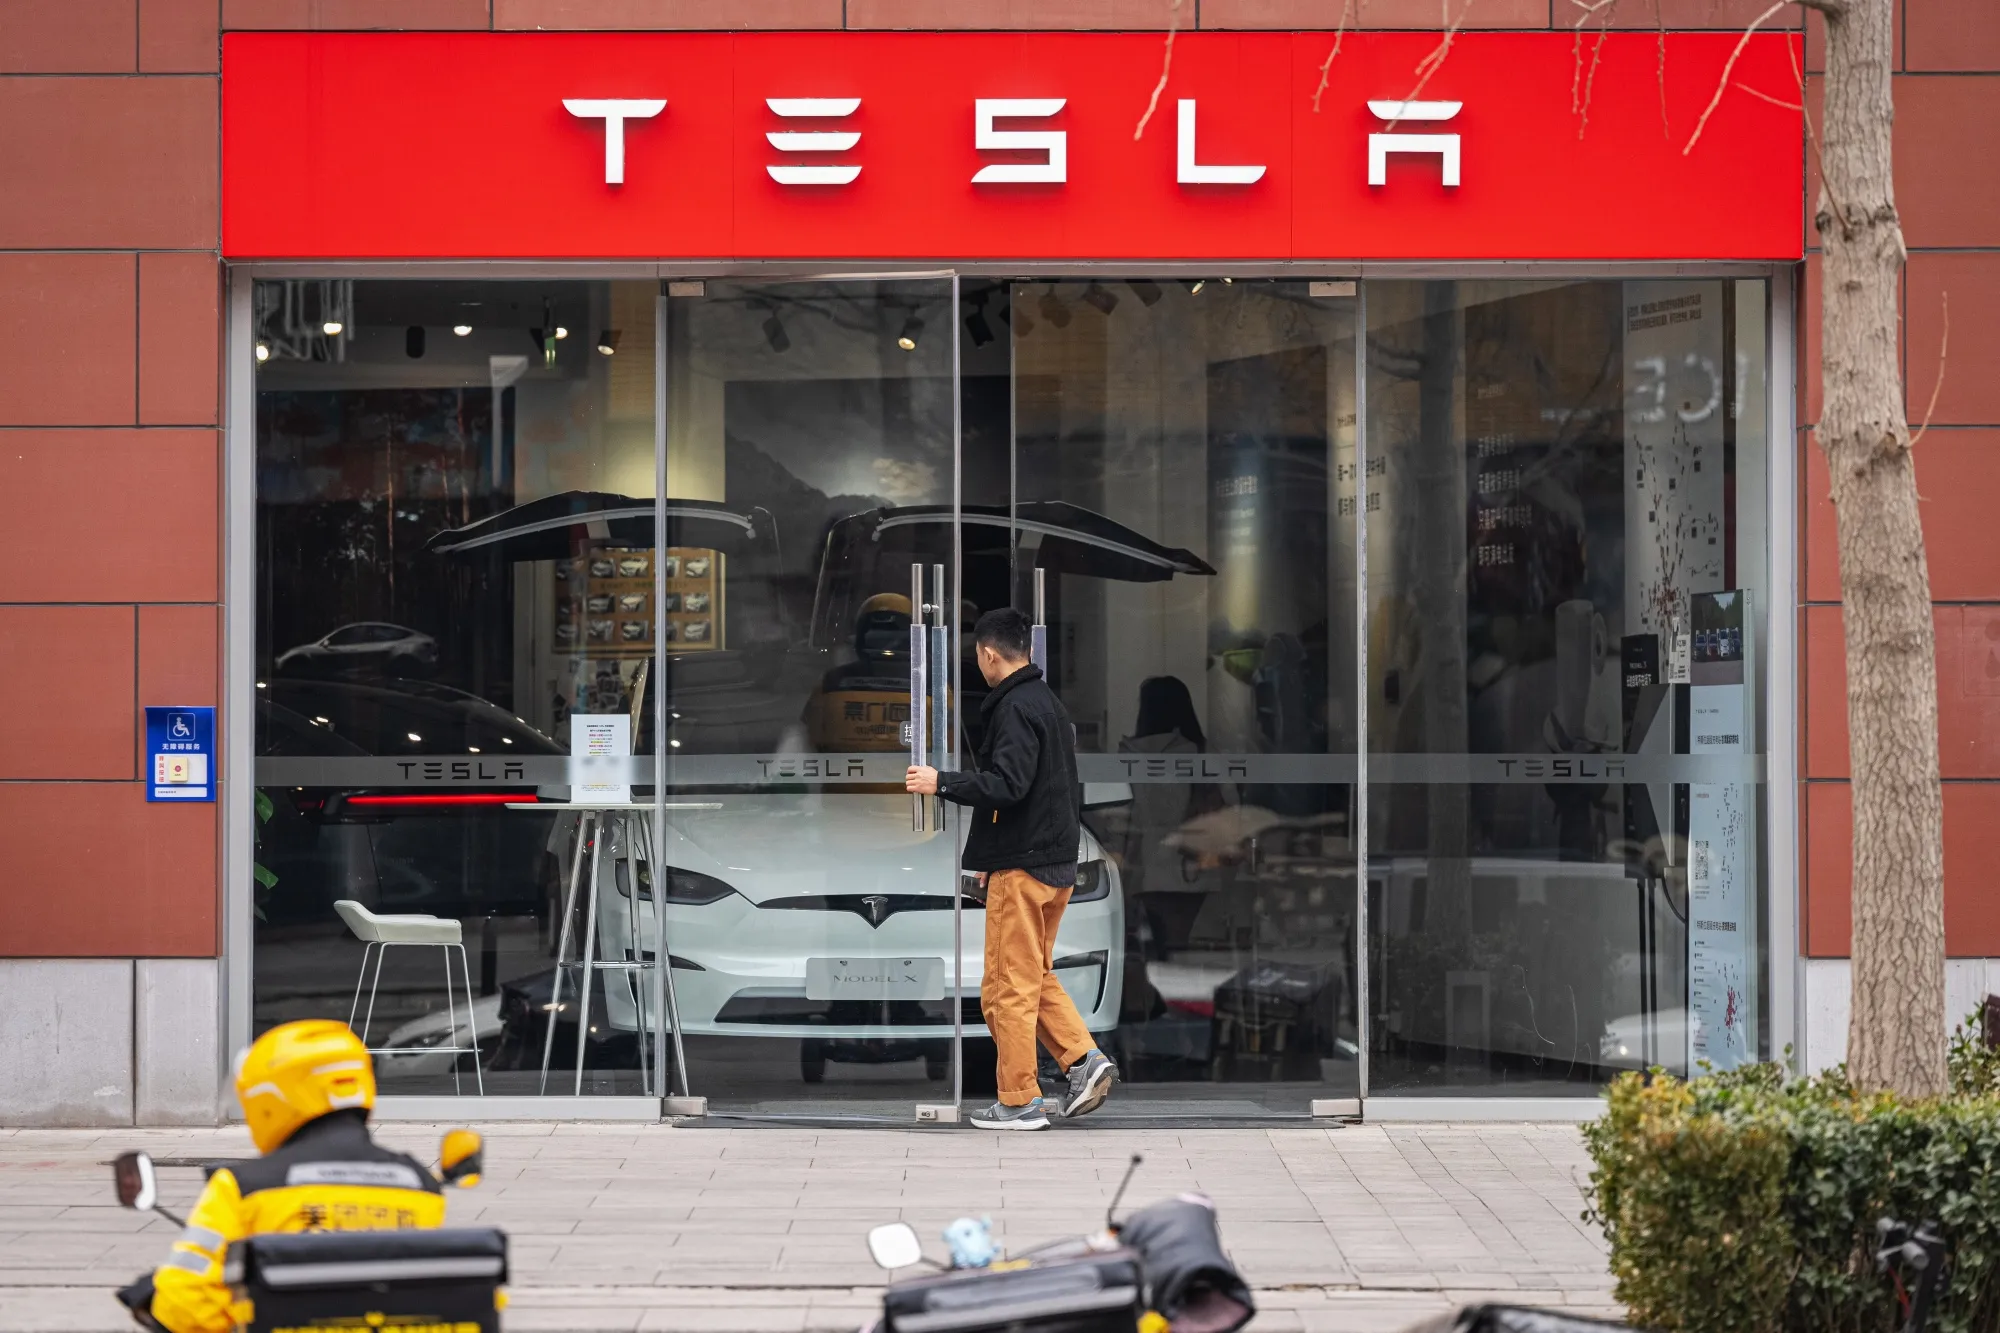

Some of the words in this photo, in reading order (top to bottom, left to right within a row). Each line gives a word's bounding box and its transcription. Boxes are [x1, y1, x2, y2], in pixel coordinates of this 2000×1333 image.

[562, 98, 1463, 186] TESLA
[397, 762, 524, 780] TESLA
[757, 759, 864, 777] TESLA
[1119, 759, 1247, 777] TESLA
[1497, 759, 1626, 777] TESLA
[834, 975, 899, 983] MODEL
[904, 975, 918, 983] X
